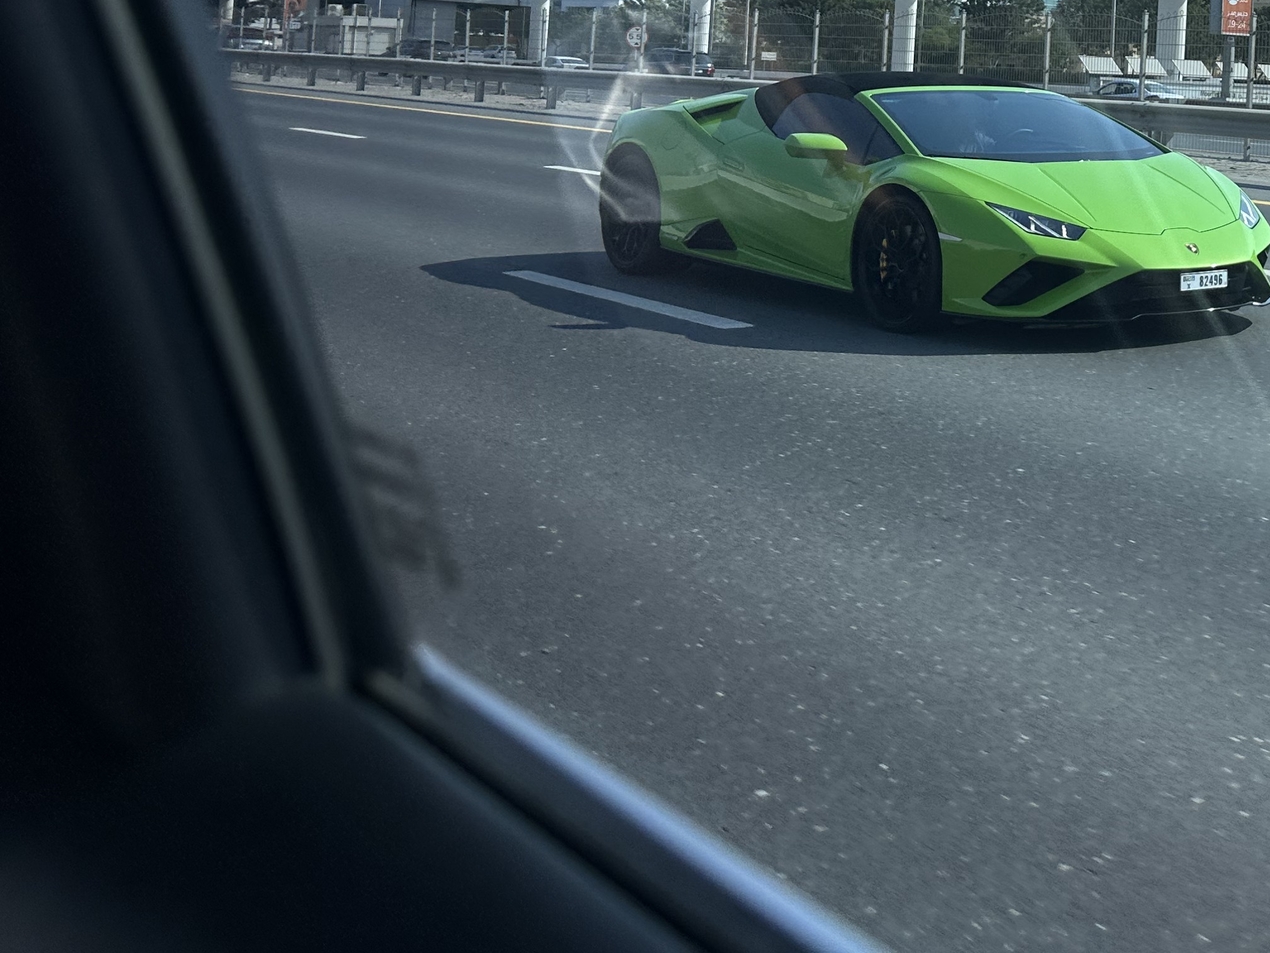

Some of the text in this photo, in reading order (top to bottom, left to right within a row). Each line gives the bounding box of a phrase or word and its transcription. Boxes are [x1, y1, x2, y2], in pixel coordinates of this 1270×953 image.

[1226, 10, 1249, 18] ديسمبر
[1227, 19, 1246, 29] 19-24
[1199, 274, 1223, 287] 82496
